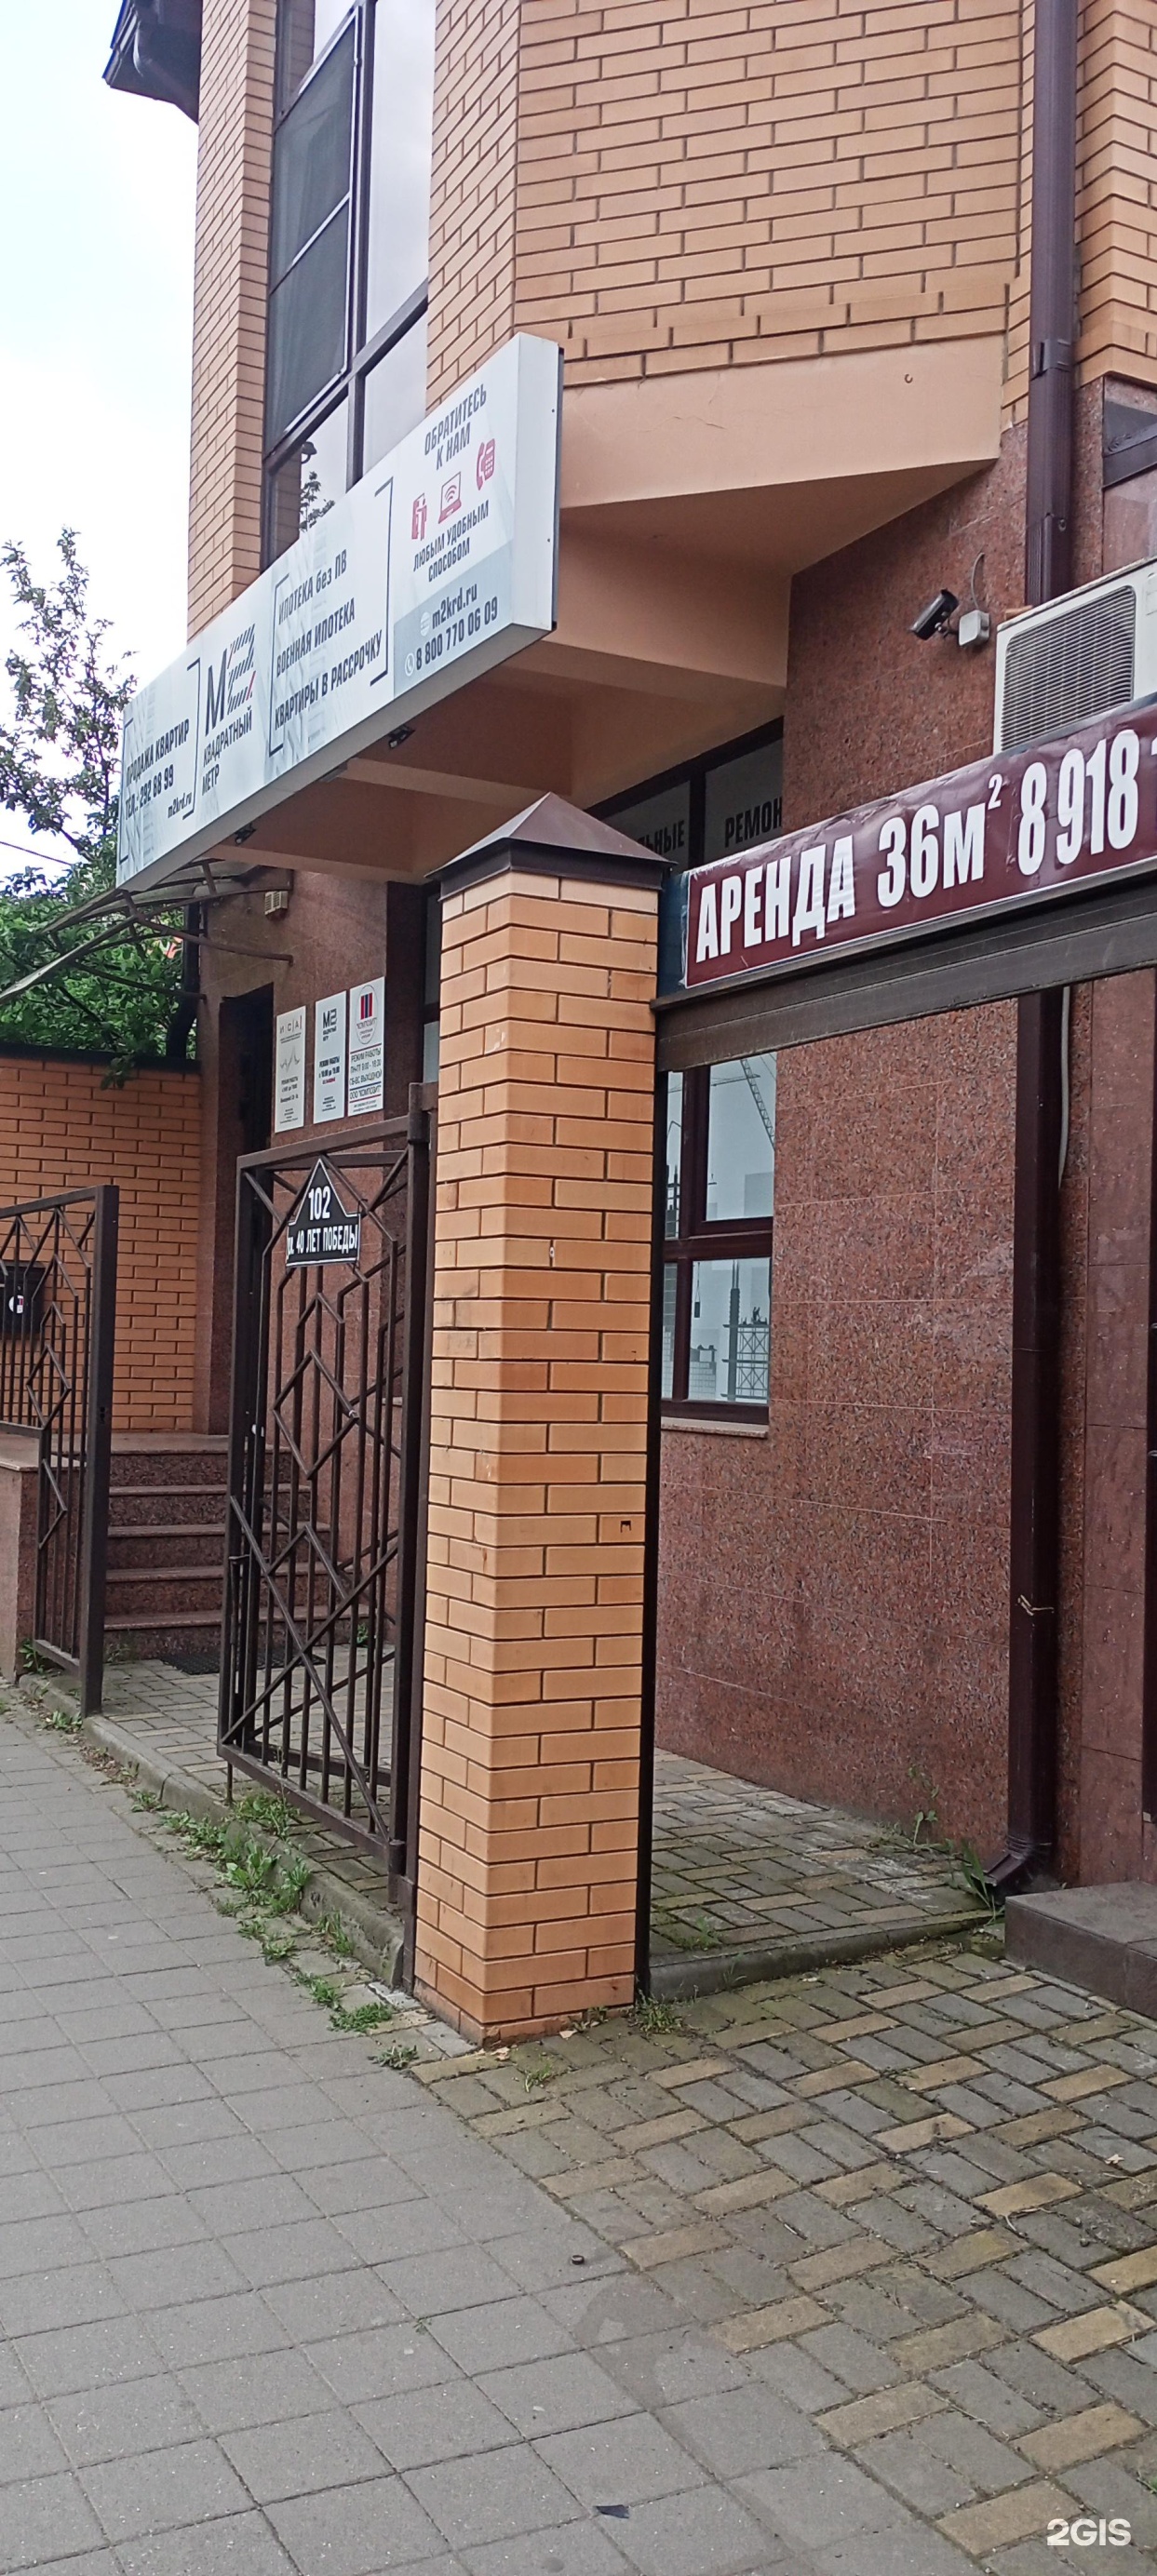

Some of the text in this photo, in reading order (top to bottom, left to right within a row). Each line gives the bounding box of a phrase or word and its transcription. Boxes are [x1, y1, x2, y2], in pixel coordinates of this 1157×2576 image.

[424, 383, 487, 455] ОБРАТИТЕСЬ
[437, 422, 471, 470] К НАМ
[413, 500, 489, 571] ЛЮБЫМ УДОБНЫМ
[428, 537, 470, 582] СПОСОБОМ
[278, 549, 347, 625] ИПОТЕКА без ПВ
[432, 584, 478, 629] m2krd.ru
[276, 597, 355, 678] ВОЕННАЯ ИПОТЕКА
[416, 596, 498, 670] 8 800 770 06 09
[275, 629, 383, 731] КВАРТИРЫ В РАССРОЧКУ
[126, 718, 190, 787] ПРОДАЖА КВАРТИР
[203, 704, 253, 768] КВАДРАТНЫЙ
[140, 779, 151, 809] 292
[153, 771, 162, 798] 88
[164, 763, 174, 790] 99
[168, 792, 192, 819] m2krd.ru
[202, 764, 220, 796] МЕТР
[695, 834, 855, 963] АРЕНДА
[1017, 761, 1047, 876] 8
[1056, 729, 1139, 865] 918
[308, 1186, 331, 1221] 102
[296, 1229, 305, 1254] 40
[306, 1228, 322, 1254] ЛЕТ
[322, 1224, 358, 1254] ПОБЕДЫ
